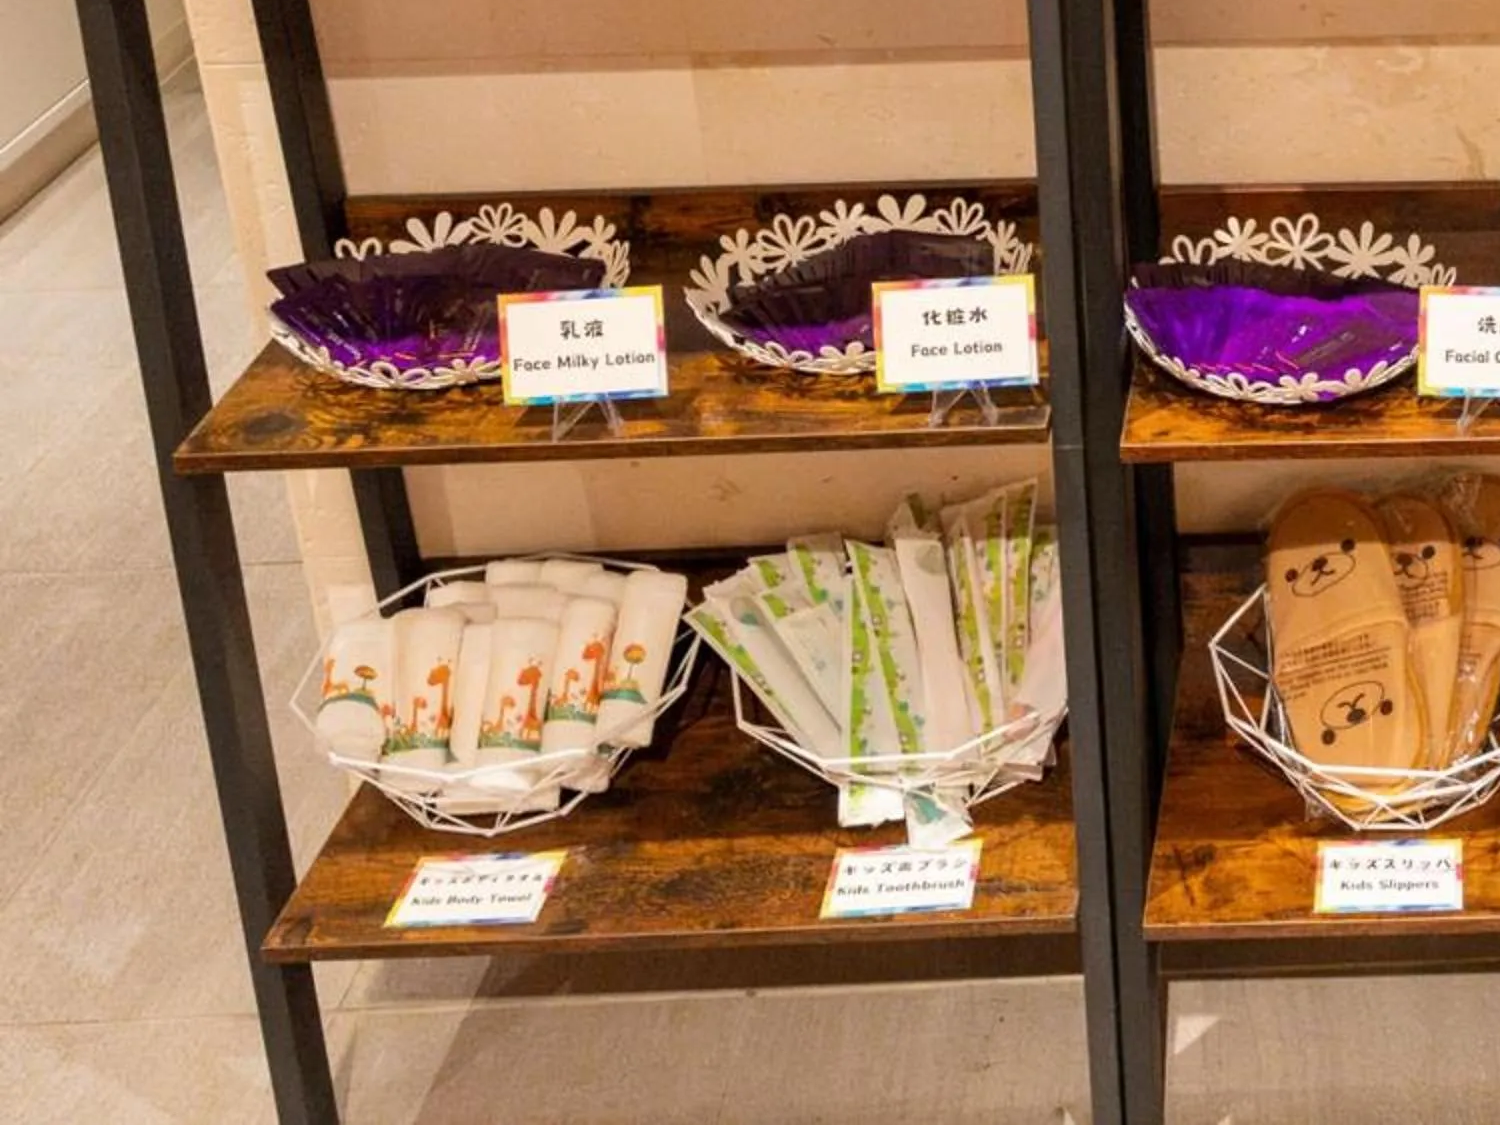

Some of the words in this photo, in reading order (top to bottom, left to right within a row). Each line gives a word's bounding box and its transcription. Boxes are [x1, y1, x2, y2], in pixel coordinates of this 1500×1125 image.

[922, 307, 988, 326] 化粧水
[560, 321, 604, 340] 乳液
[911, 344, 948, 357] Face
[954, 342, 1003, 355] Lotion
[1445, 349, 1490, 363] Facial
[513, 357, 552, 372] Face
[557, 354, 600, 370] Milky
[605, 352, 655, 366] Lotion
[837, 884, 869, 896] Kids
[877, 879, 965, 893] Toothbrush
[1340, 880, 1373, 890] Kids
[1378, 879, 1440, 891] Slippers
